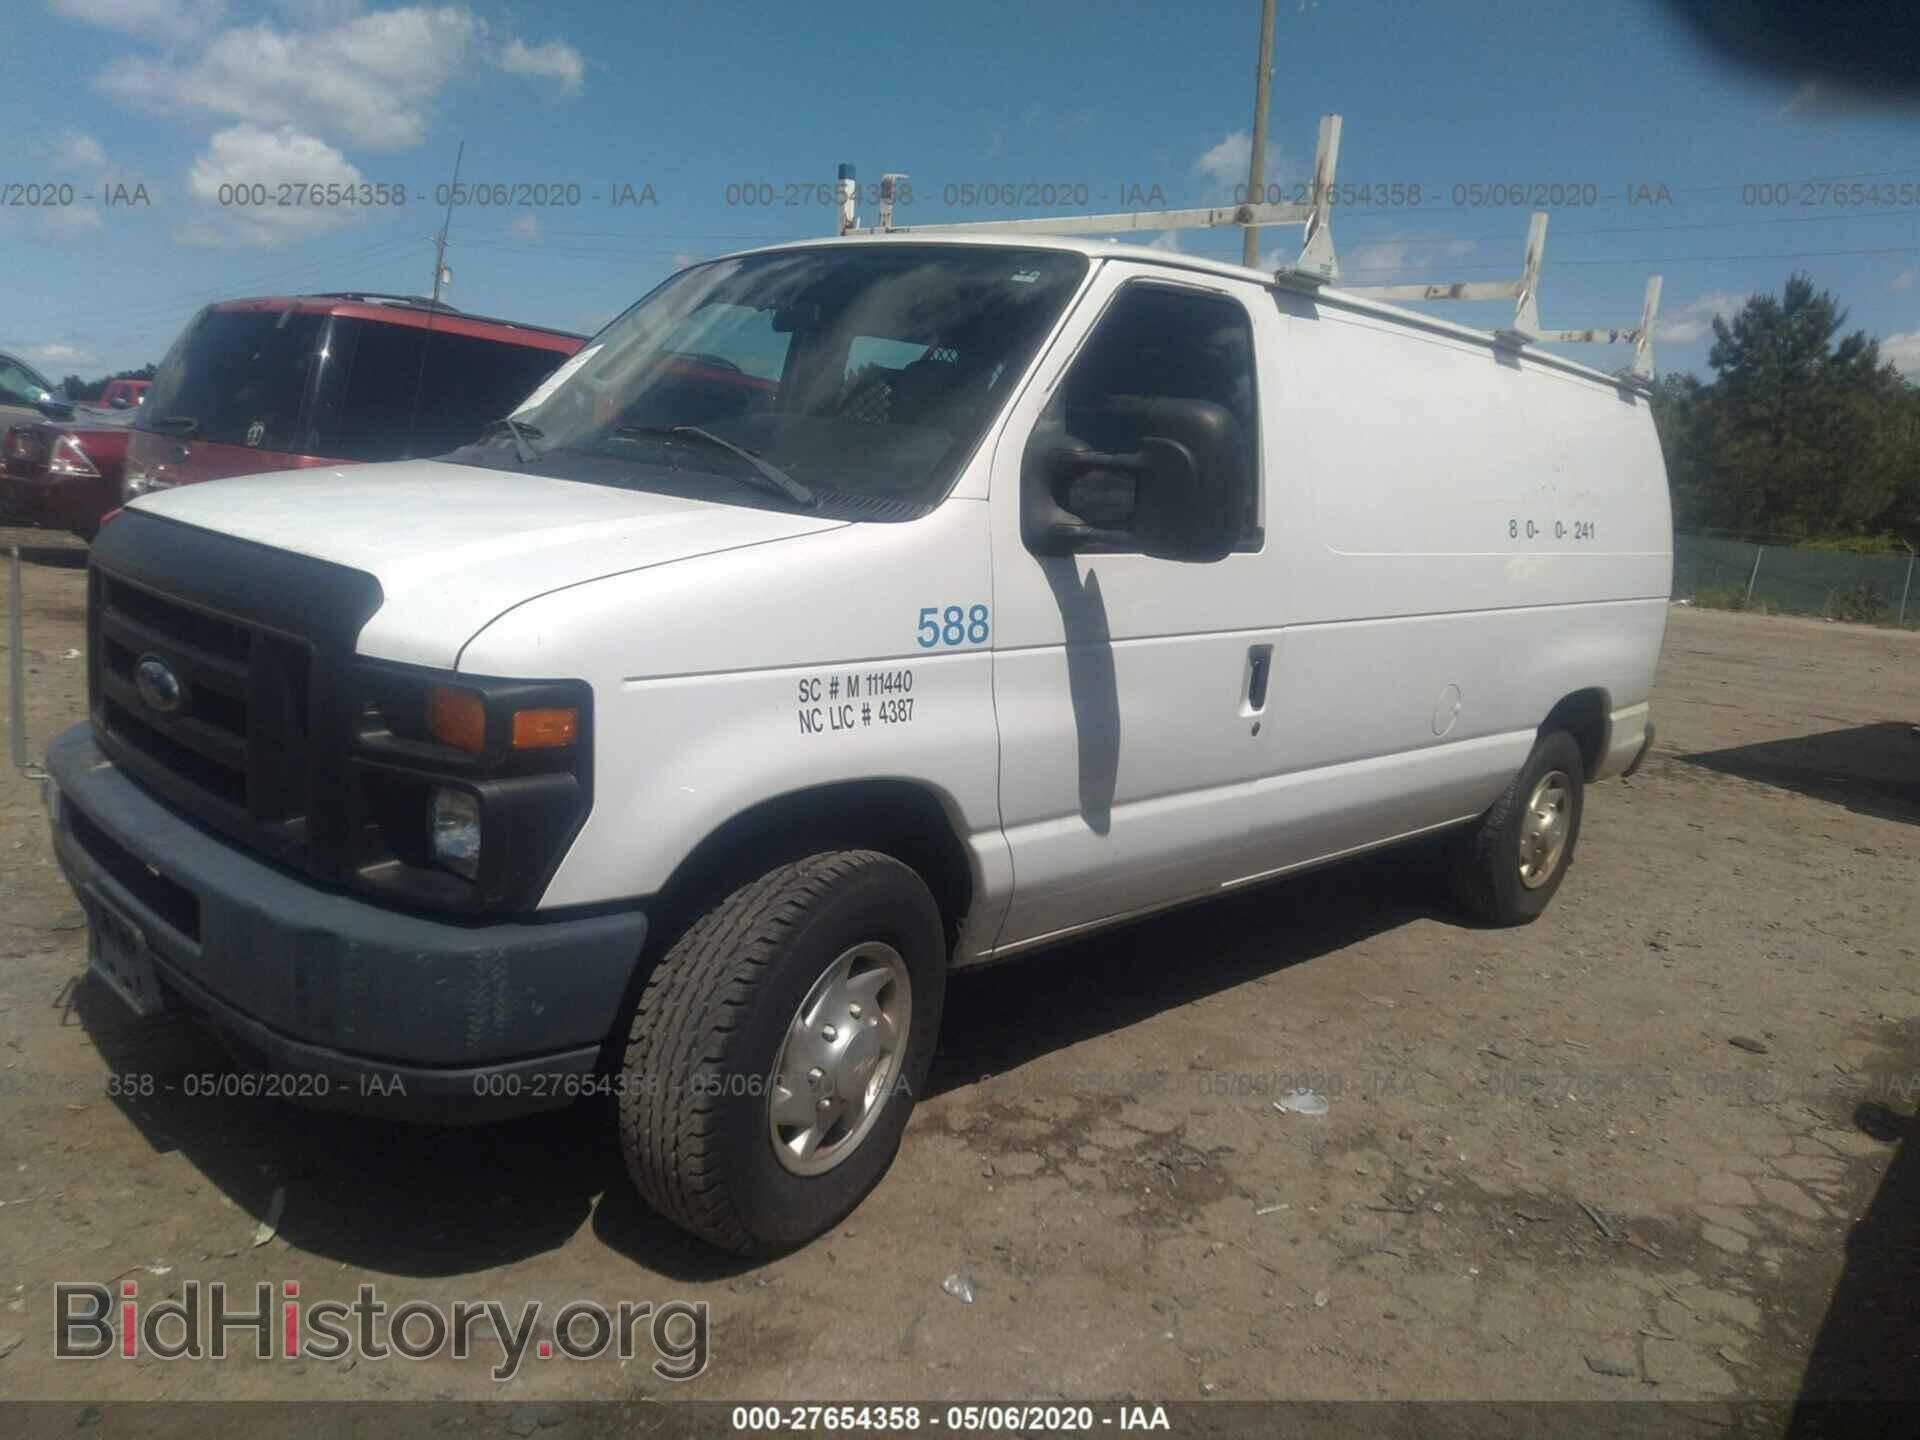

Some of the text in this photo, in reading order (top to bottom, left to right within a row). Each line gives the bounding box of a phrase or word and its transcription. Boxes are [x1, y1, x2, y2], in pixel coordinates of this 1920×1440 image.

[916, 603, 990, 648] 588
[798, 669, 913, 703] SC # M 111440
[798, 698, 914, 734] NC LIC # 4387
